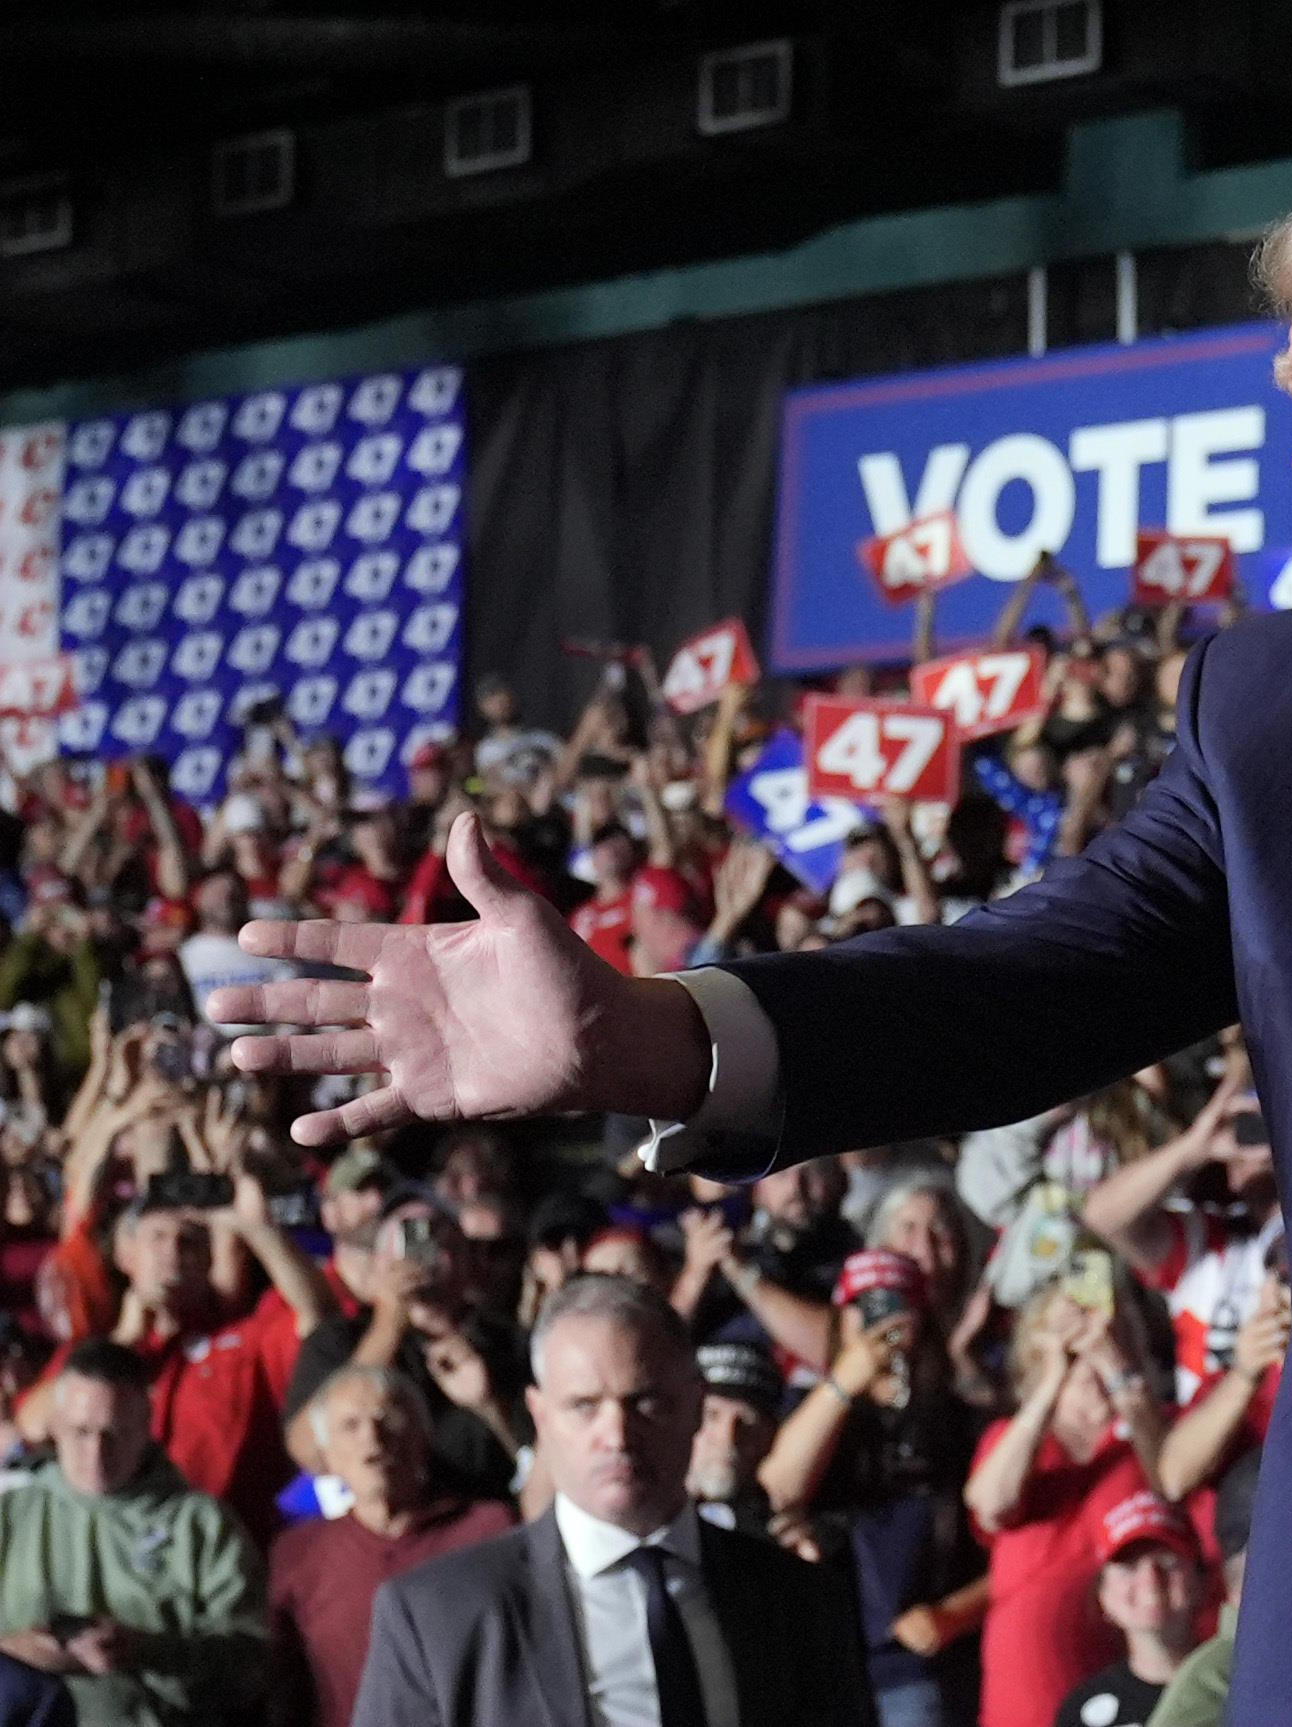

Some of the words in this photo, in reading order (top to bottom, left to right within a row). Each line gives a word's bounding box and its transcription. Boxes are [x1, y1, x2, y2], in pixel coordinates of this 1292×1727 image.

[858, 404, 1266, 582] VOTE
[1139, 541, 1224, 597] 47
[663, 630, 736, 707] 47
[931, 651, 1031, 728] 47
[816, 711, 945, 793] 47
